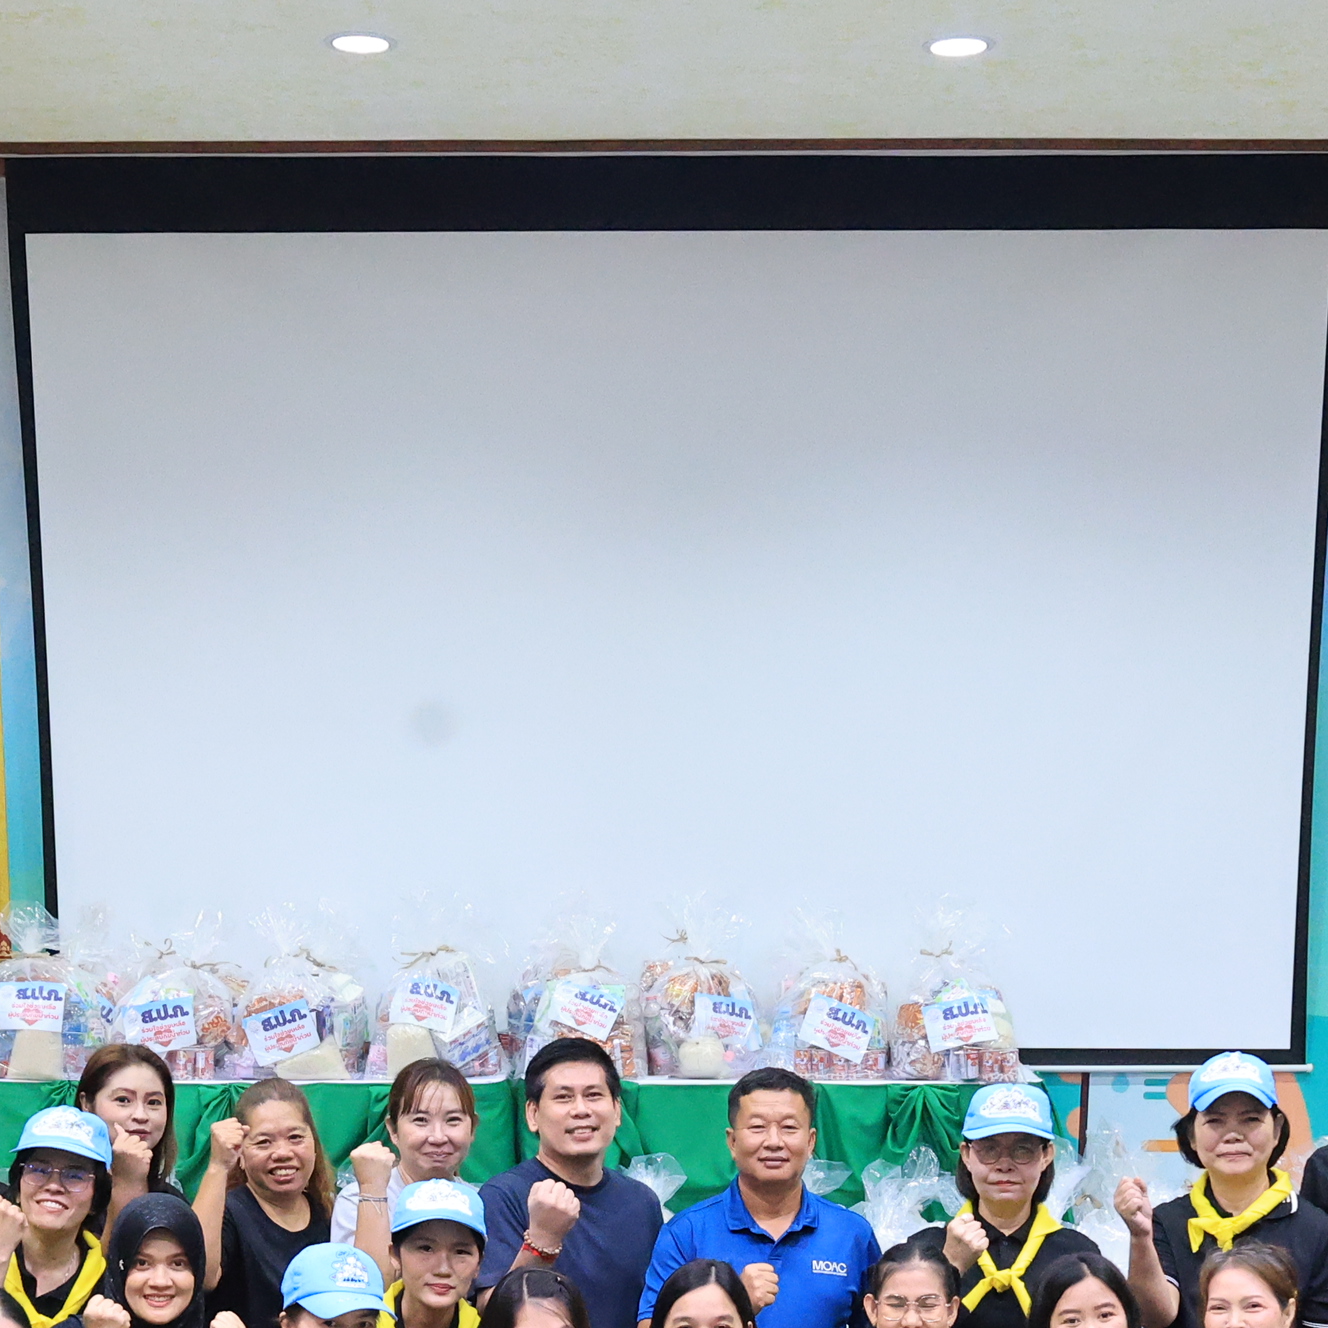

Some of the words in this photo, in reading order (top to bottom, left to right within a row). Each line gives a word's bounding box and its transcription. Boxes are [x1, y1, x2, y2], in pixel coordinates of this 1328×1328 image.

[141, 1004, 189, 1024] ส.ป.ก.
[262, 1009, 307, 1031] ส.ป.ก.
[826, 1007, 868, 1034] ส.ป.ก.
[813, 1260, 847, 1273] MOAC
